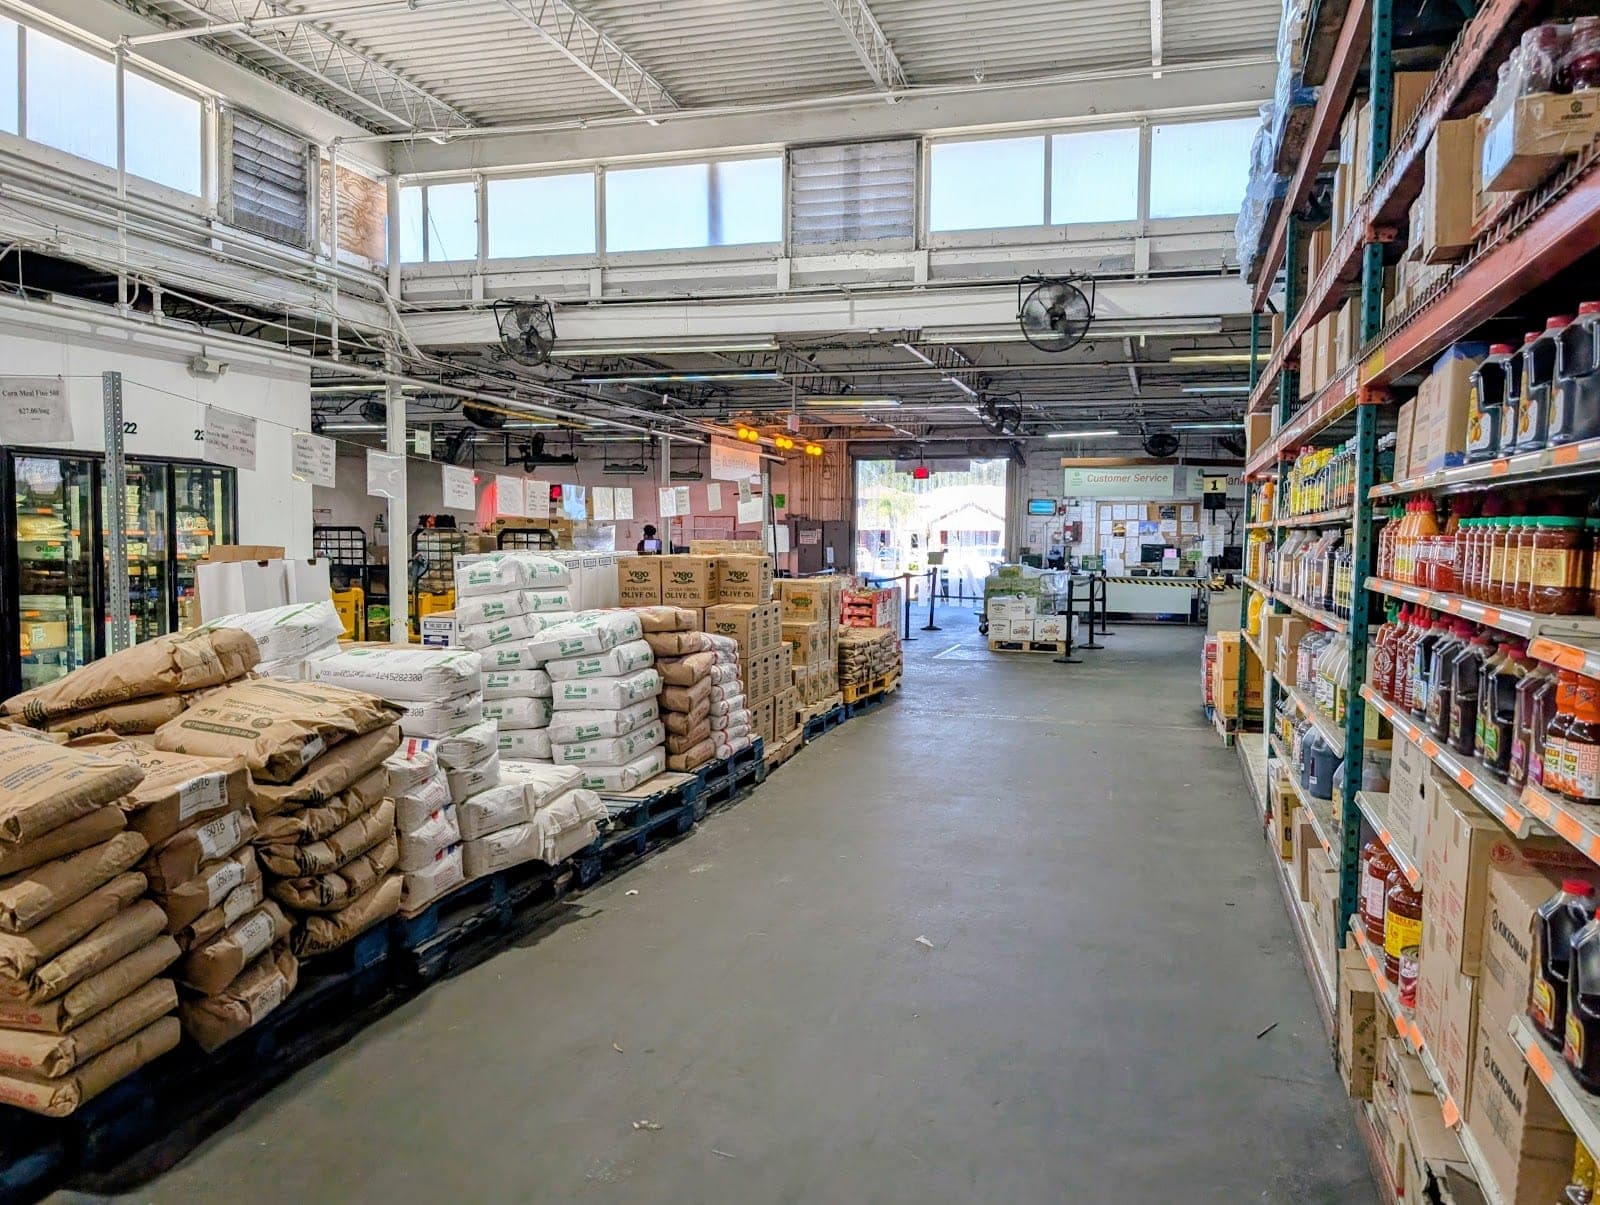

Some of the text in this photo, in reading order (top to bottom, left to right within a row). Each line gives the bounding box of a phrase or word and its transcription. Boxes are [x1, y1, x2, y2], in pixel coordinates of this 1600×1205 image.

[19, 389, 35, 397] Meal
[123, 422, 138, 434] 22
[1087, 473, 1131, 483] Customer
[1134, 473, 1168, 483] Service
[1211, 479, 1218, 490] 1
[621, 591, 657, 599] OLIVE OIL
[719, 590, 742, 598] OLIVE
[1498, 921, 1529, 964] KIKKOMAN
[1490, 1057, 1523, 1116] KIKKOMAN
